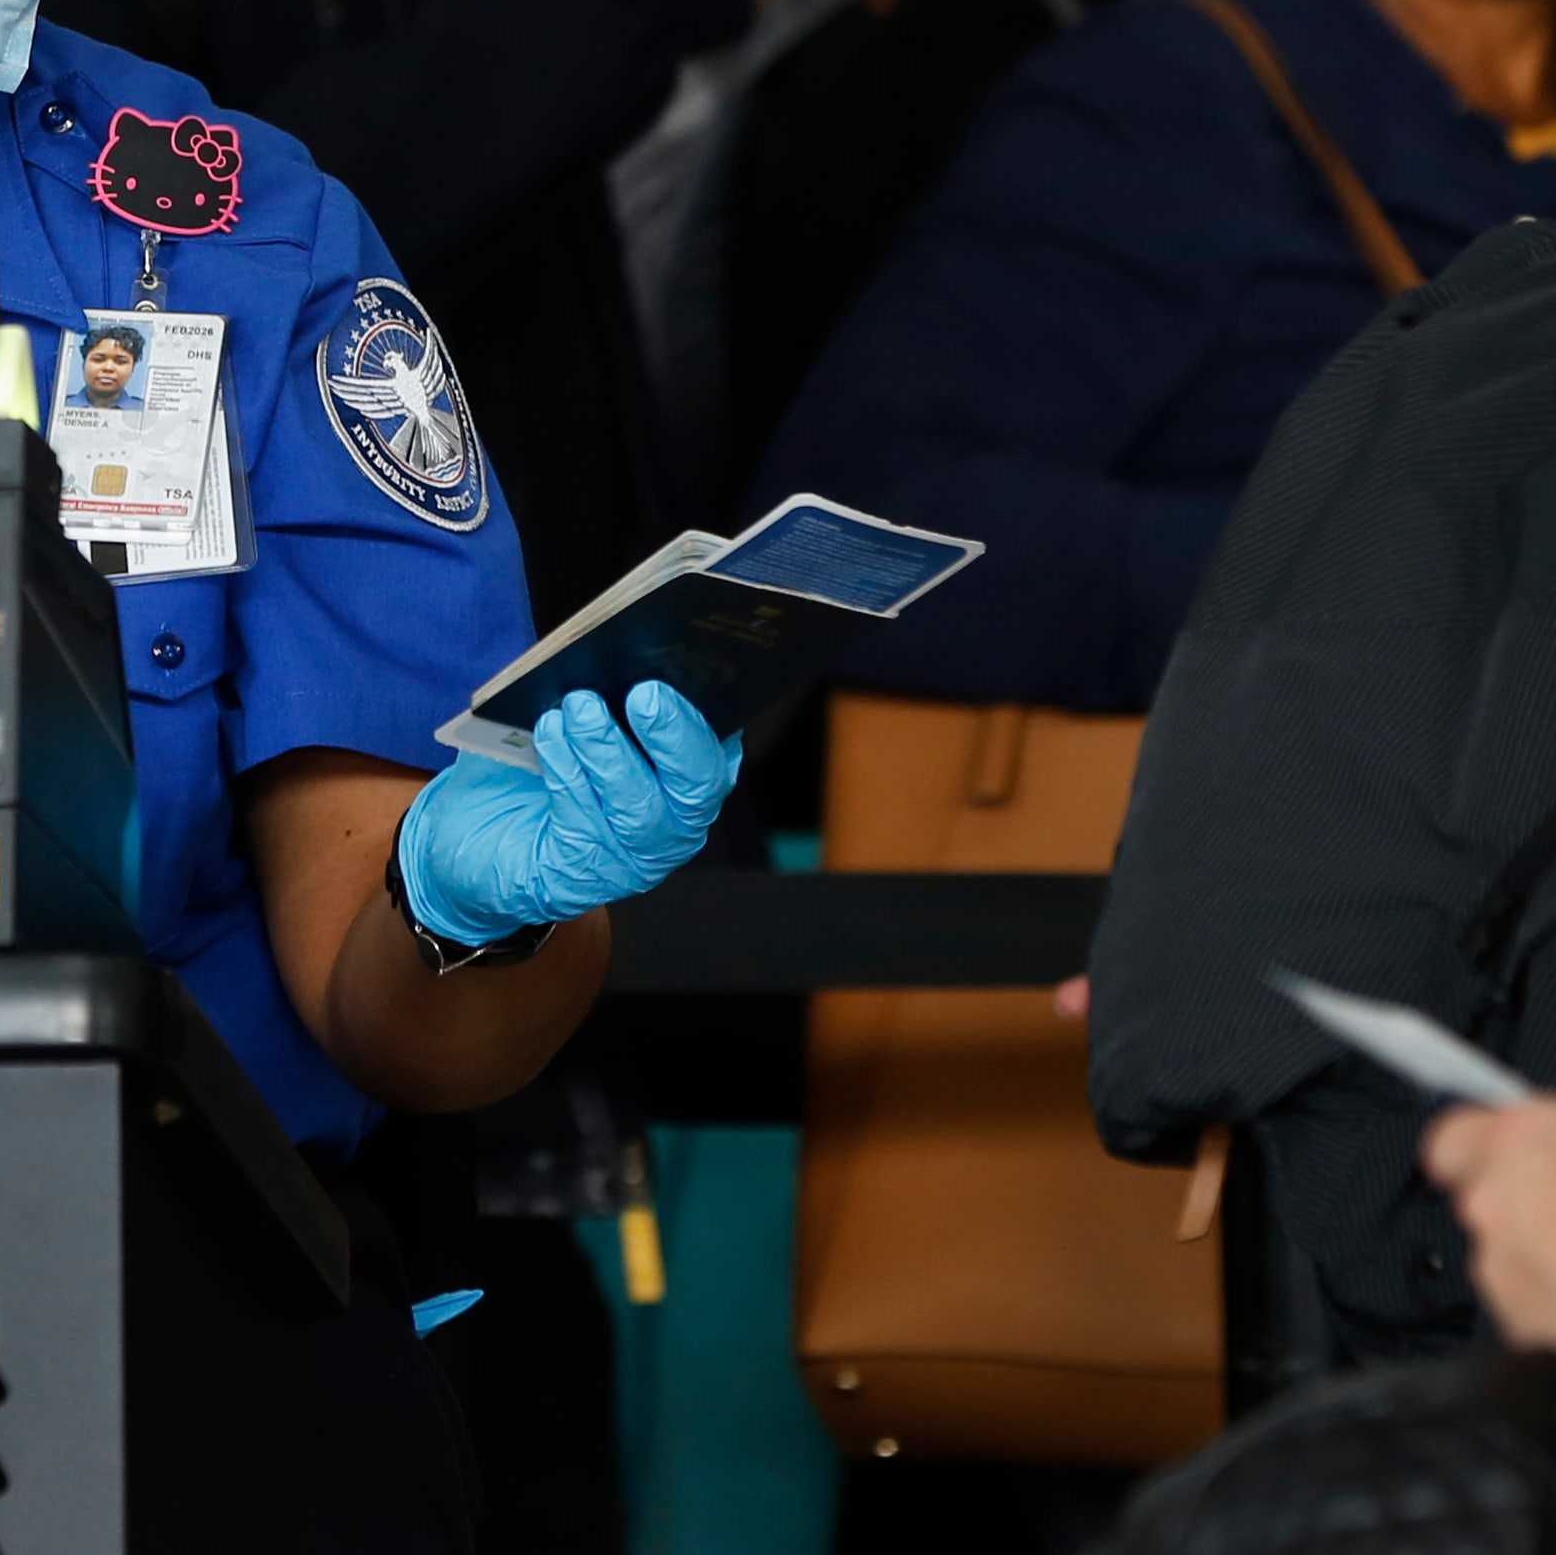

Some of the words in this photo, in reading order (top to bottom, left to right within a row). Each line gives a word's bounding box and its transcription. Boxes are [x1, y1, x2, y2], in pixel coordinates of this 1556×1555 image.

[353, 291, 382, 313] TSA
[164, 325, 214, 337] FEB2026
[188, 350, 212, 361] DHS
[65, 410, 101, 420] MYERS,
[64, 419, 99, 428] DENISE
[102, 421, 109, 429] A
[61, 487, 78, 495] SA
[164, 487, 194, 500] TSA
